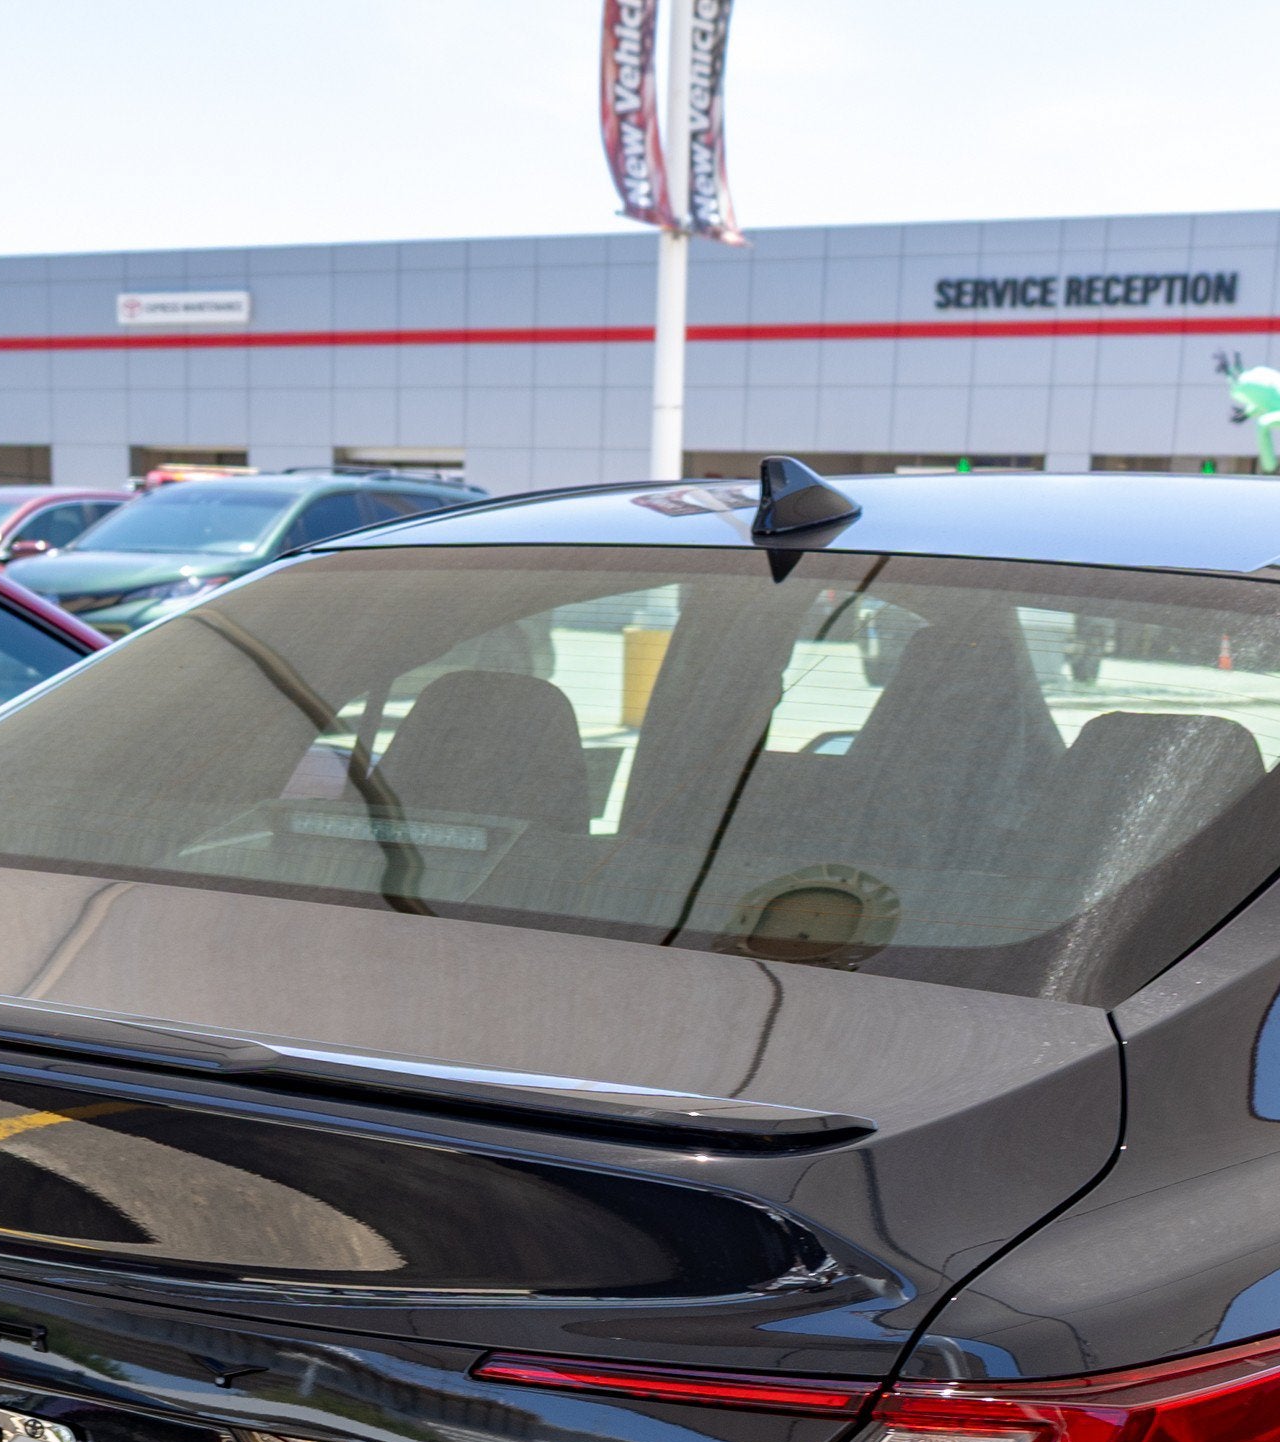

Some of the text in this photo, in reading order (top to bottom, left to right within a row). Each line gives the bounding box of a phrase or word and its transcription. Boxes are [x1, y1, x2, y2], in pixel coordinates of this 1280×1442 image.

[622, 118, 652, 208] New
[691, 140, 721, 224] New
[934, 271, 1238, 309] SERVICE RECEPTION
